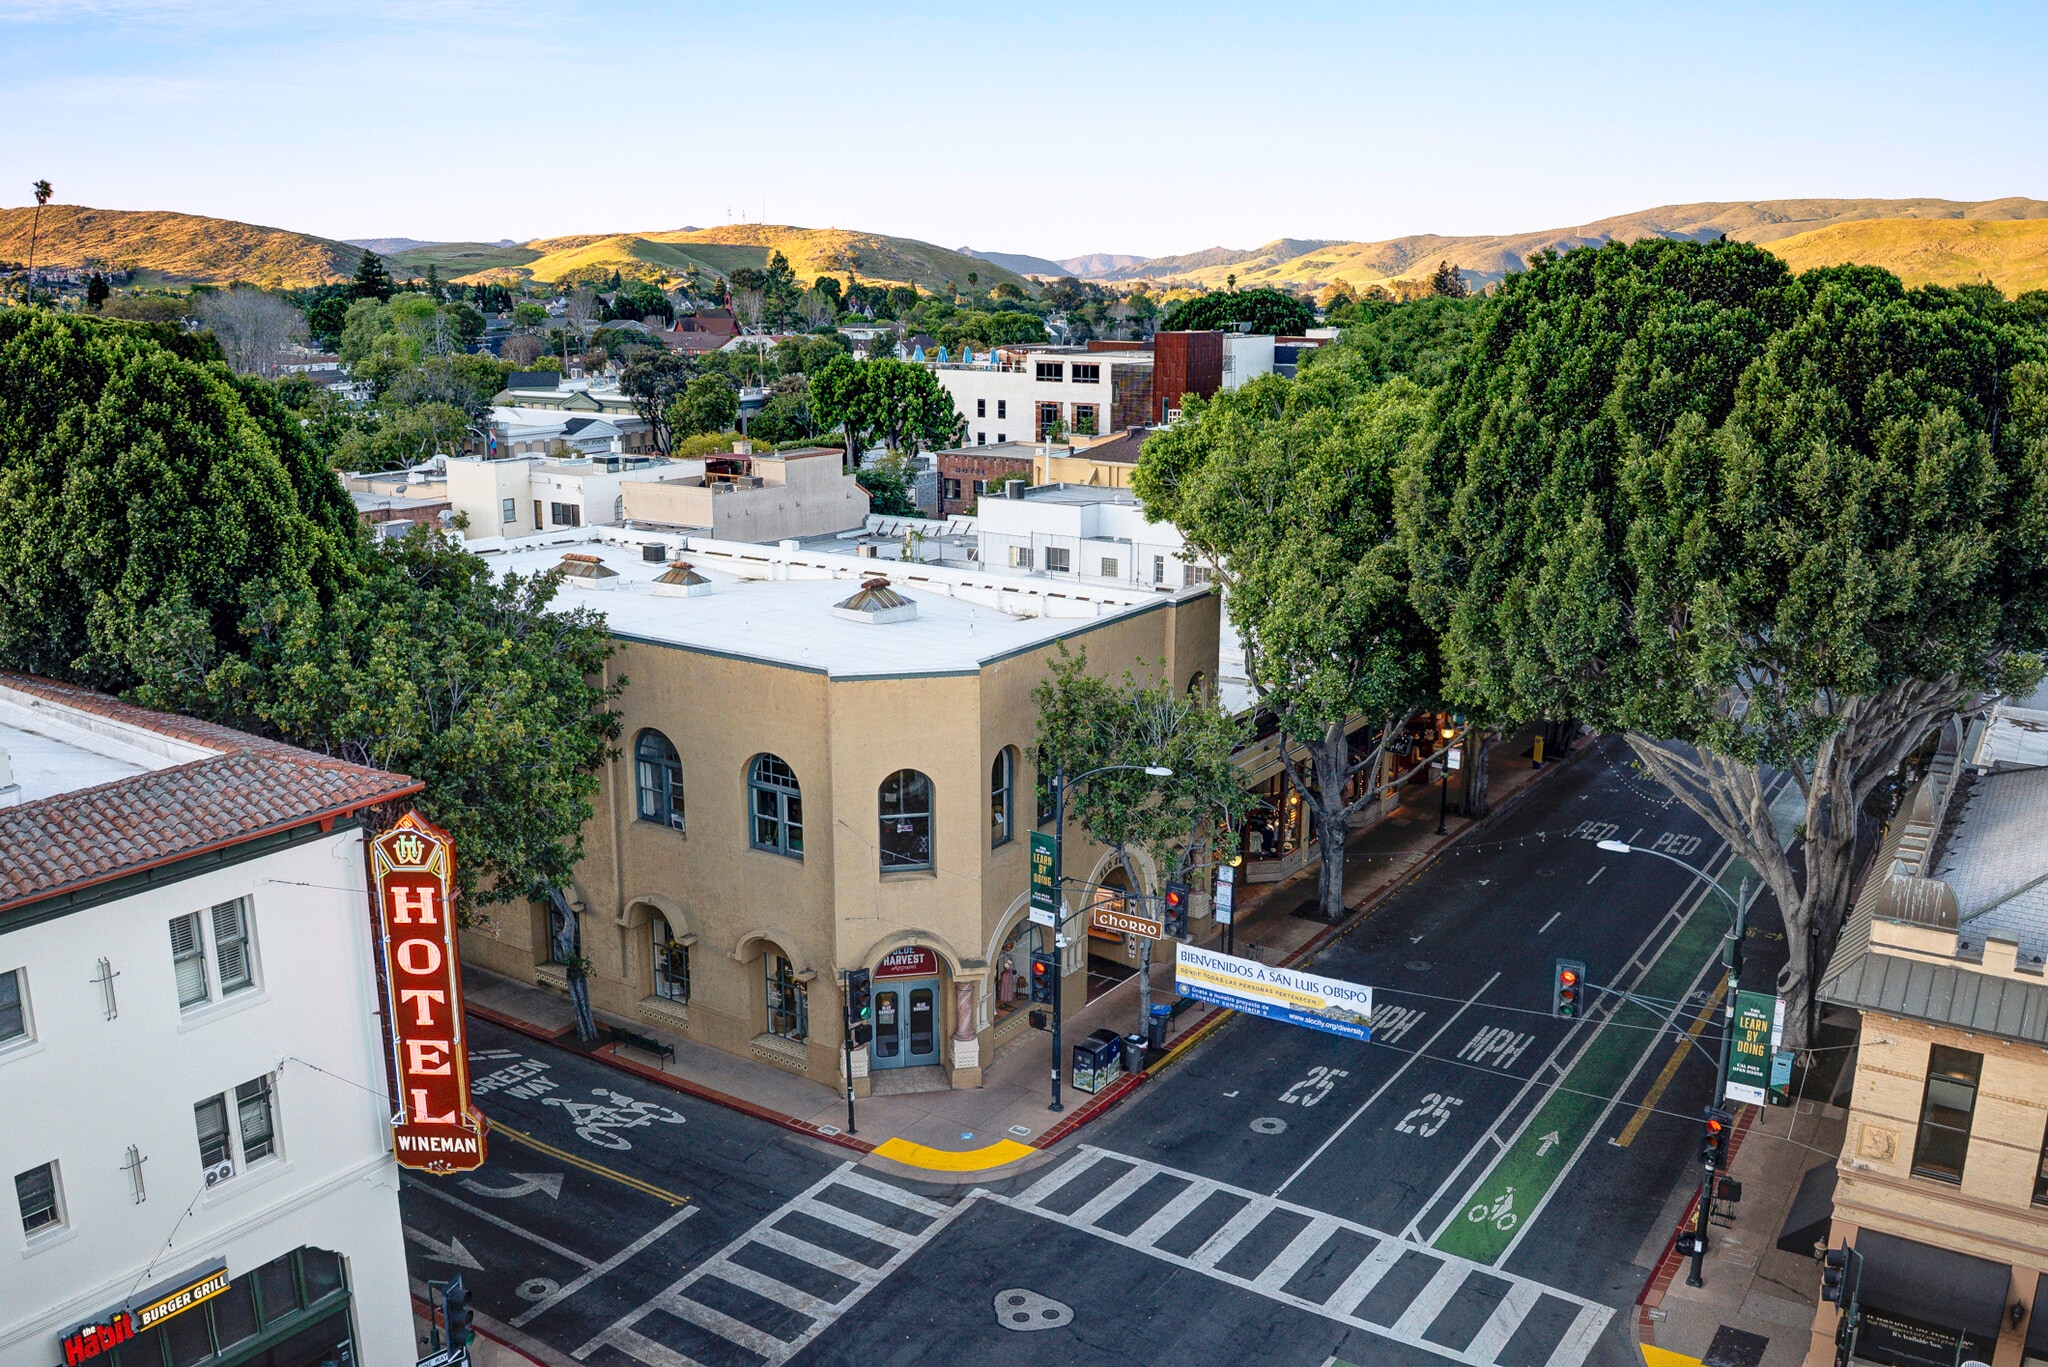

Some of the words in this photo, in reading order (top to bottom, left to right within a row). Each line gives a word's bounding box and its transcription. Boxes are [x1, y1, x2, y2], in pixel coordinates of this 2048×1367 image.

[1568, 820, 1619, 840] PED
[1651, 832, 1702, 856] PED
[1033, 853, 1052, 867] LEARN
[1038, 864, 1047, 875] BY
[1033, 873, 1052, 887] DOING
[883, 954, 925, 966] HARVEST
[1180, 967, 1202, 978] DONDE
[1203, 973, 1224, 984] TODAS
[1225, 979, 1238, 987] LAS
[1238, 983, 1274, 995] PERSONAS
[1274, 990, 1317, 1005] PERTENECEN
[1181, 952, 1253, 978] BIENVENIDOS
[1256, 969, 1266, 981] A
[1269, 971, 1292, 988] SAN
[1295, 978, 1319, 993] LUIS
[1323, 984, 1367, 1003] OBISPO
[390, 886, 457, 1124] HOTEL
[1235, 998, 1261, 1010] proyecto
[1261, 1003, 1270, 1011] de
[1288, 1013, 1365, 1037] www.slocity.org/diversity
[1739, 1016, 1768, 1033] LEARN
[1457, 1025, 1535, 1069] MPH
[1746, 1030, 1759, 1042] BY
[1737, 1040, 1765, 1057] DOING
[470, 1058, 552, 1096] GREEN
[503, 1075, 560, 1100] WAY
[1279, 1066, 1349, 1107] 25
[1395, 1093, 1464, 1138] 25
[398, 1135, 477, 1153] WINEMAN
[142, 1293, 191, 1326] BURGER
[193, 1275, 227, 1300] GRILL
[64, 1313, 135, 1367] Habit
[82, 1326, 96, 1338] the
[434, 1355, 449, 1364] WAY
